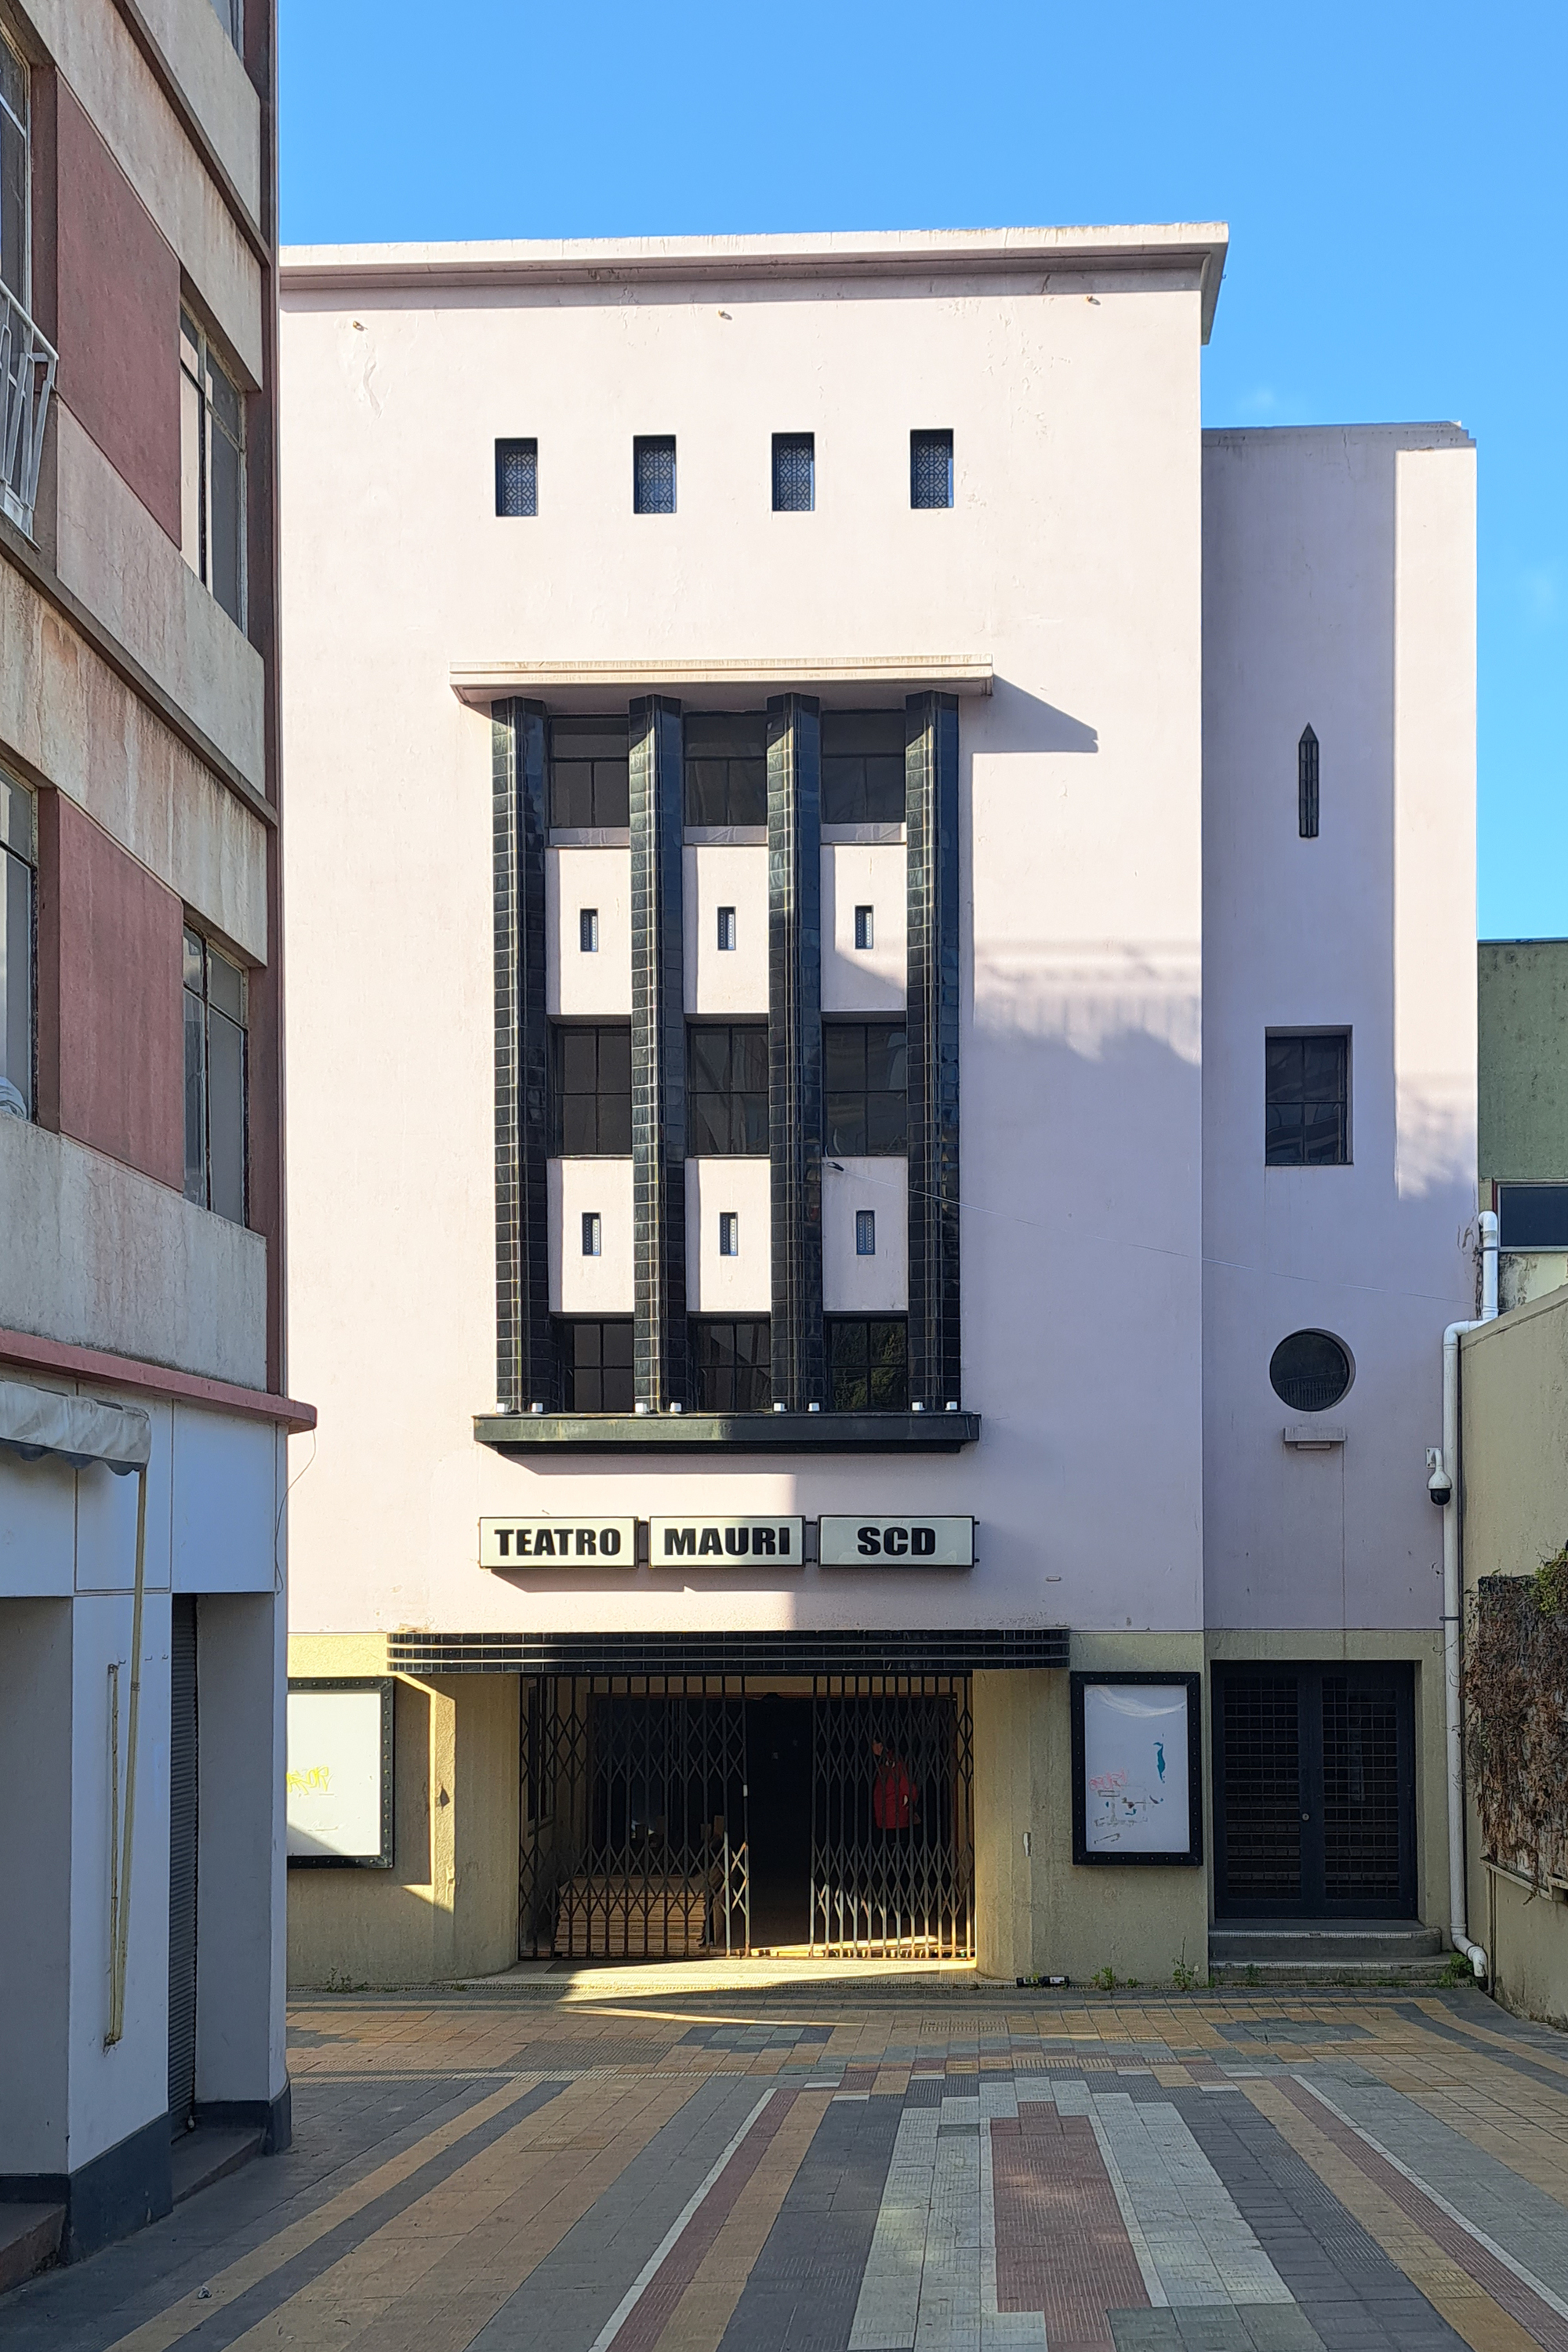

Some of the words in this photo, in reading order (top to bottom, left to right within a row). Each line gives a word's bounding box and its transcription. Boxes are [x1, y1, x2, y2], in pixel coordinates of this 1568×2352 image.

[494, 1527, 622, 1556] TEATRO
[663, 1526, 791, 1556] MAURI
[856, 1526, 937, 1556] SCD
